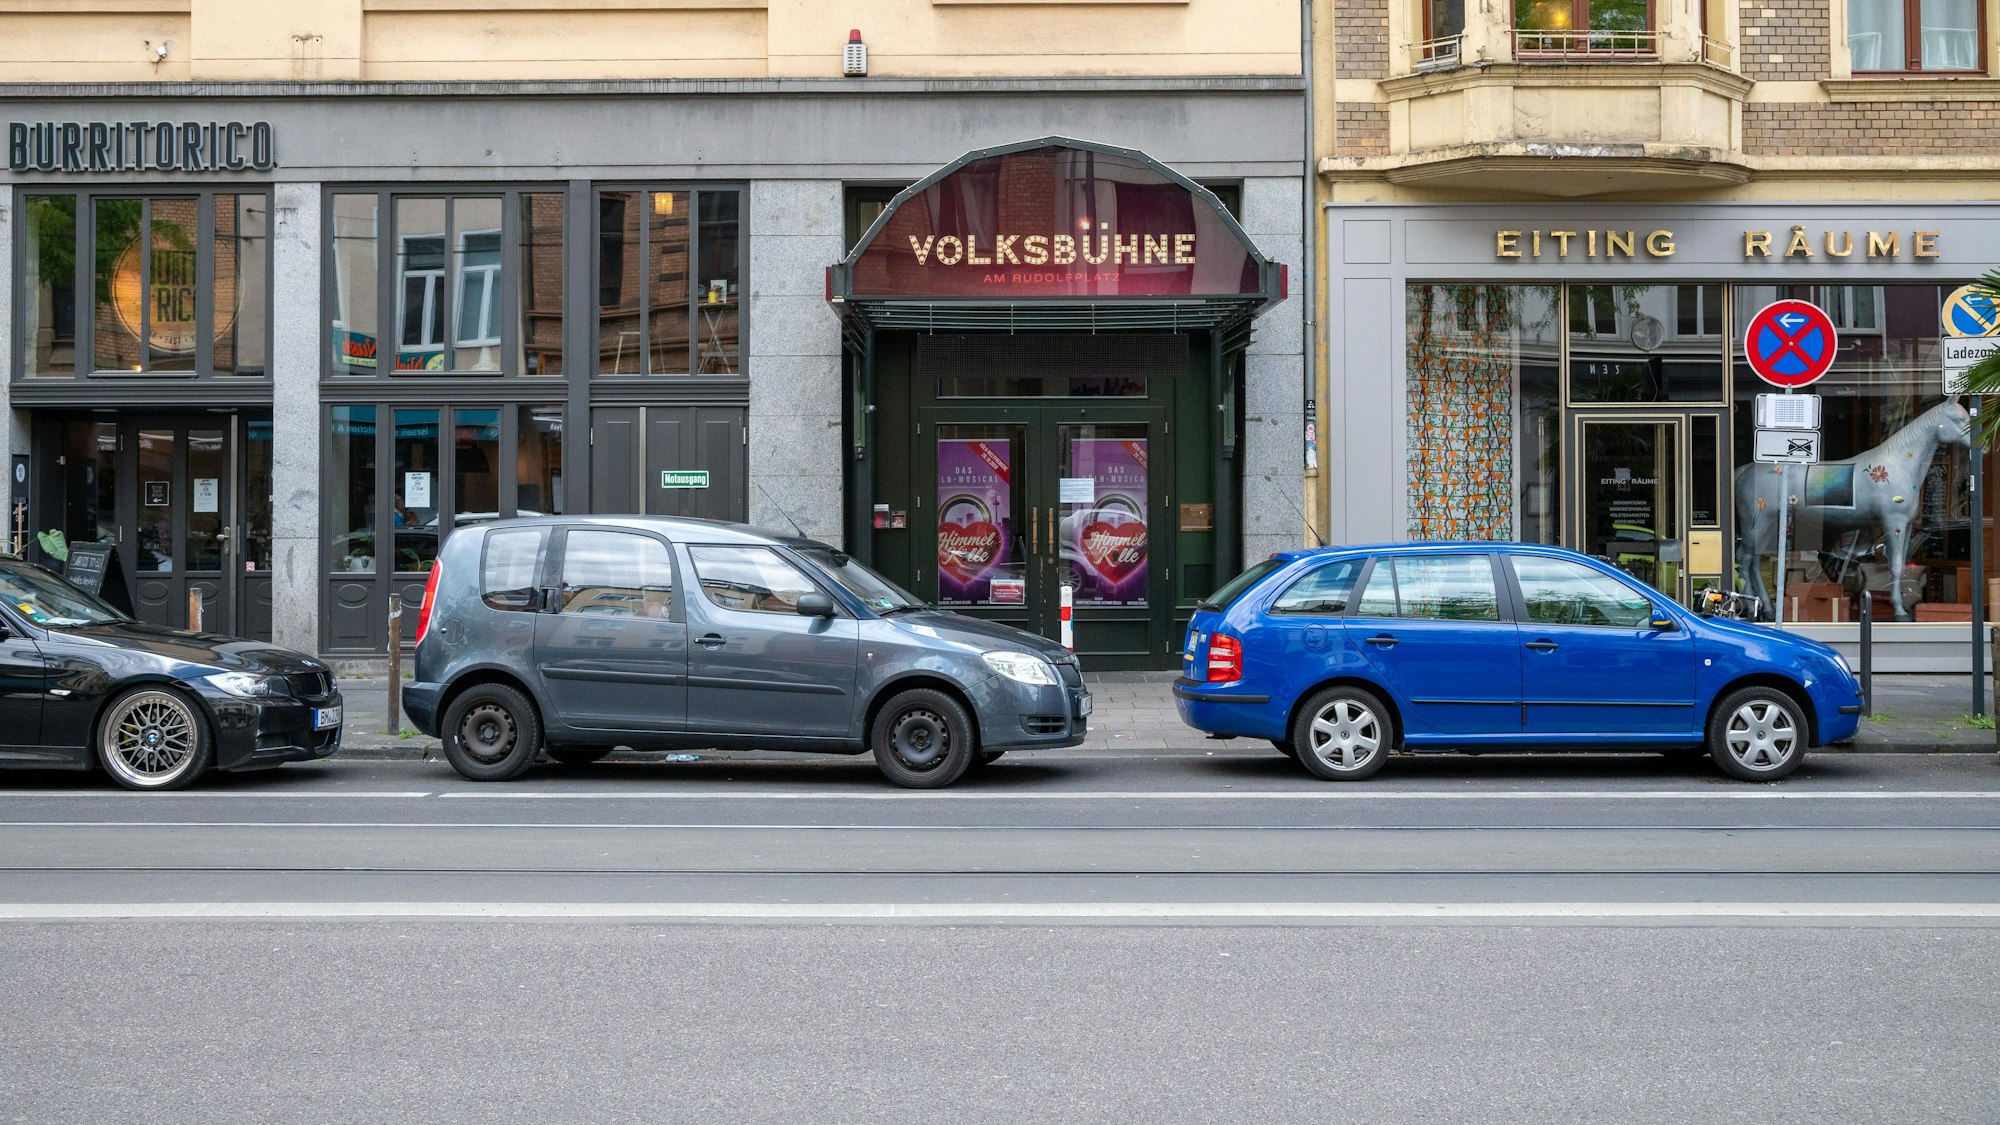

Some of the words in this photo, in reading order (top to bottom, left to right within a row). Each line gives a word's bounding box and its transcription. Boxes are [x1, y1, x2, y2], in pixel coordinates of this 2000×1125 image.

[9, 121, 274, 171] BURRITORICO
[909, 222, 1196, 266] VOLKSBÜHNE
[1496, 229, 1677, 258] EITING
[1744, 225, 1941, 258] RÄUME
[983, 273, 1006, 283] AM
[1013, 273, 1121, 283] RUDOLFPLATZ
[164, 335, 182, 345] FAST
[1947, 346, 1993, 359] Ladezo
[955, 466, 973, 474] DAS
[1108, 466, 1125, 474] DAS
[664, 473, 706, 486] Notausgang
[941, 475, 1000, 484] LN-MUSICAL
[1631, 477, 1659, 485] RÄUME
[938, 530, 996, 551] Himmel
[1088, 530, 1146, 550] Himmel
